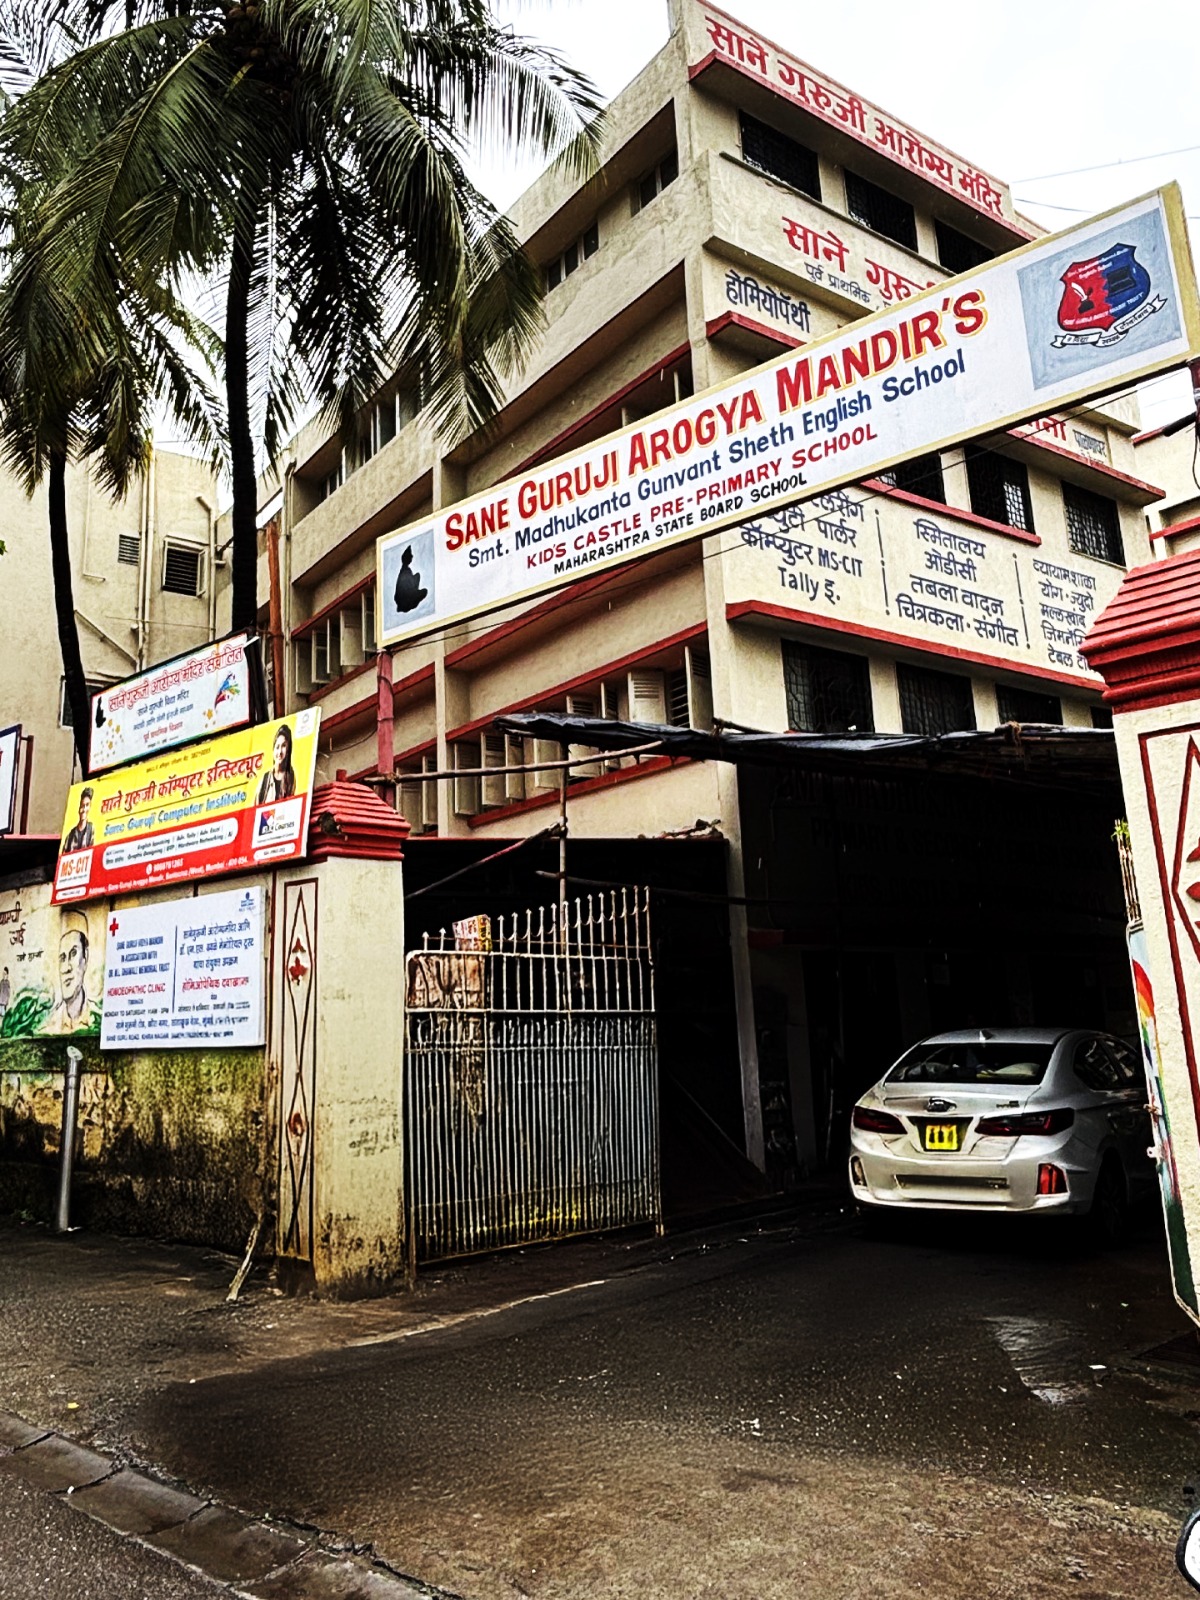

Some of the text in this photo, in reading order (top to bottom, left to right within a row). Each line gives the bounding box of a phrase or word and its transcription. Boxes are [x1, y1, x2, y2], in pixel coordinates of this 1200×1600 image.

[705, 15, 1004, 218] साने गुरुजी आरोग्य मंदिर
[782, 216, 936, 300] साने गुरु
[725, 269, 811, 333] होमियोपॅथी
[828, 273, 871, 304] प्राथमिक
[445, 289, 988, 552] SANE GURUJI AROGYA MANDIR'S
[469, 348, 966, 568] Smt. Madhukanta Gunvant Sheth English School
[527, 423, 878, 569] KID'S CASTLE PRE-PRIMARY SCHOOL
[553, 472, 808, 575] MAHARASHTRA STATE BOARD SCHOOL
[814, 519, 857, 548] पार्लर
[913, 518, 986, 559] स्मितालय
[818, 547, 863, 577] MS-CIT
[777, 566, 819, 601] Tally
[909, 574, 1004, 617] तबला वादन
[1038, 578, 1063, 601] योग
[896, 593, 1019, 646] चित्रकला संगीत
[1047, 643, 1074, 668] टेबल
[108, 690, 125, 712] साने
[151, 669, 181, 696] आरोग्य
[181, 657, 204, 682] मंदिर
[101, 790, 122, 814] साने
[124, 781, 156, 812] गुरुजी
[127, 812, 156, 831] Guruji
[158, 804, 203, 824] Computer
[206, 790, 247, 811] Institute
[60, 856, 89, 877] MS-CIT
[148, 982, 166, 993] CLINIC
